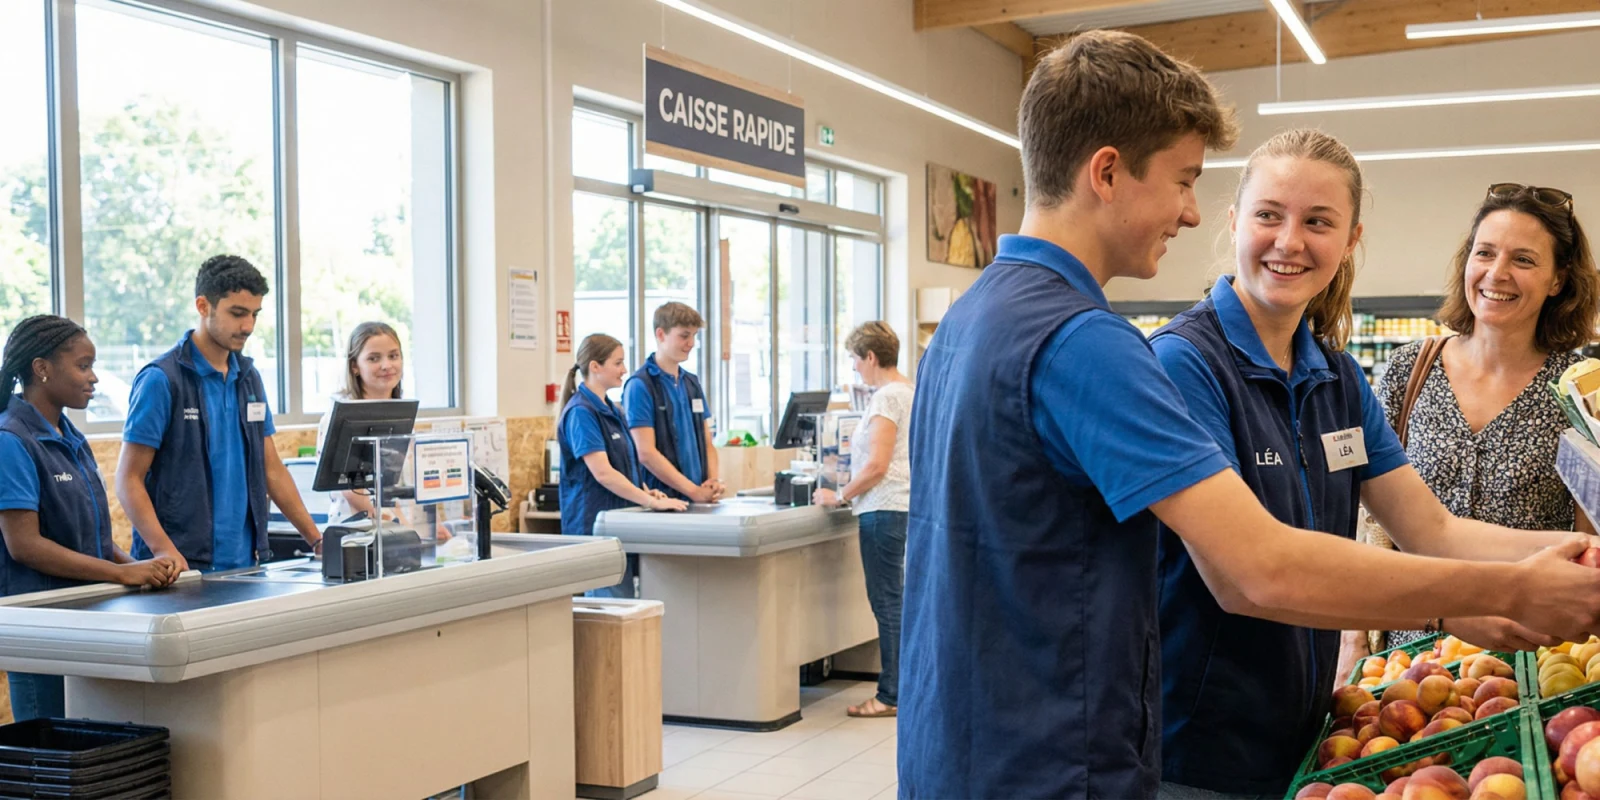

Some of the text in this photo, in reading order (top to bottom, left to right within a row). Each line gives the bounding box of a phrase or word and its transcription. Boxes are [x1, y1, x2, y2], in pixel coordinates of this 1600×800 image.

[659, 88, 796, 155] CAISSE RAPIDE
[1255, 448, 1283, 465] LÉA
[1338, 444, 1354, 457] LÉA
